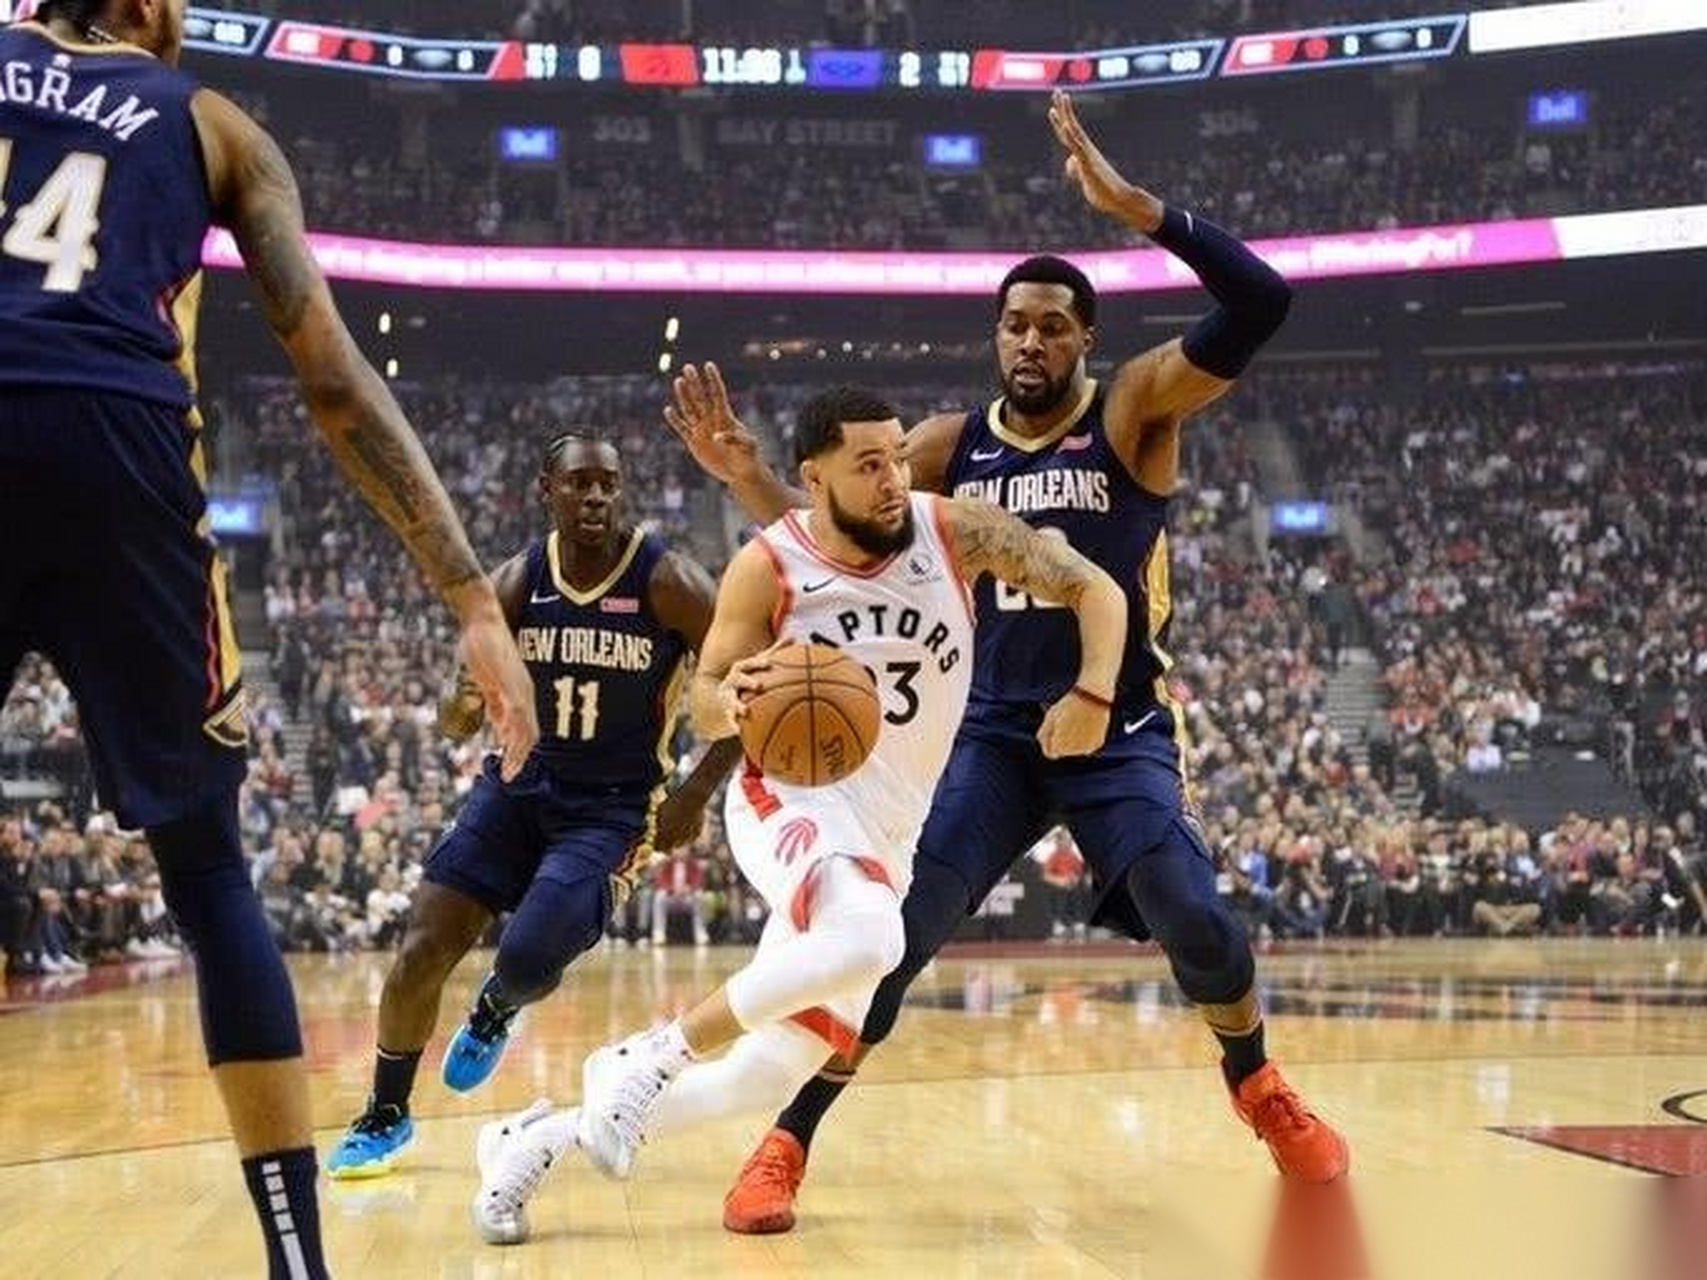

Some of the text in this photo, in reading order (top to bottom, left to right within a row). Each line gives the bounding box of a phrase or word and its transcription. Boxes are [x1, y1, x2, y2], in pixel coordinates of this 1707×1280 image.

[0, 60, 159, 141] GRAM
[785, 118, 895, 145] STREET
[1008, 469, 1109, 513] ORLEANS
[561, 627, 652, 671] ORLEANS
[810, 604, 960, 674] PTORS
[553, 676, 599, 741] 11
[864, 661, 921, 725] 3
